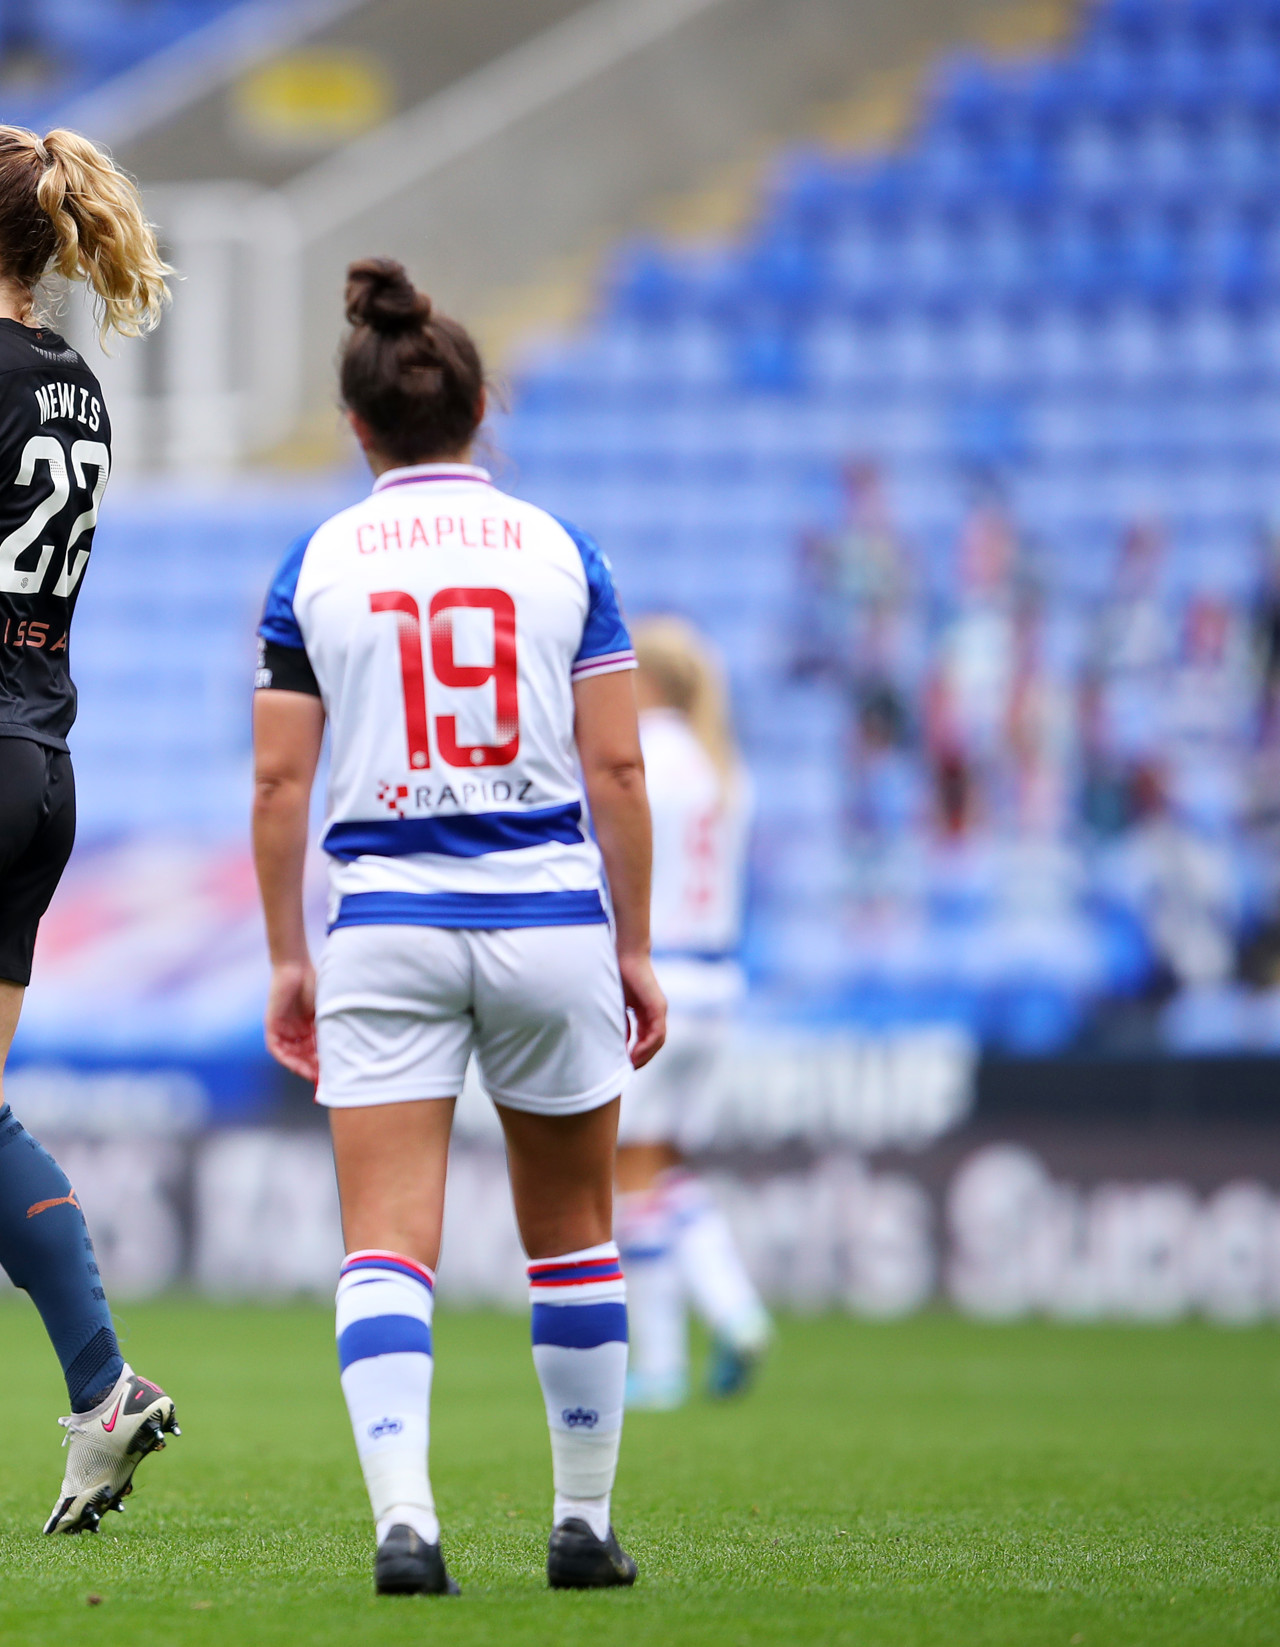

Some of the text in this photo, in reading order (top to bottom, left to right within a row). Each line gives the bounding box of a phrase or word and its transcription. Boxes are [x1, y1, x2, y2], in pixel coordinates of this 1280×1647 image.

[33, 381, 101, 433] MEWIS
[357, 516, 523, 555] CHAPLEN
[369, 587, 520, 771] 19
[416, 780, 533, 808] RAPIDZ
